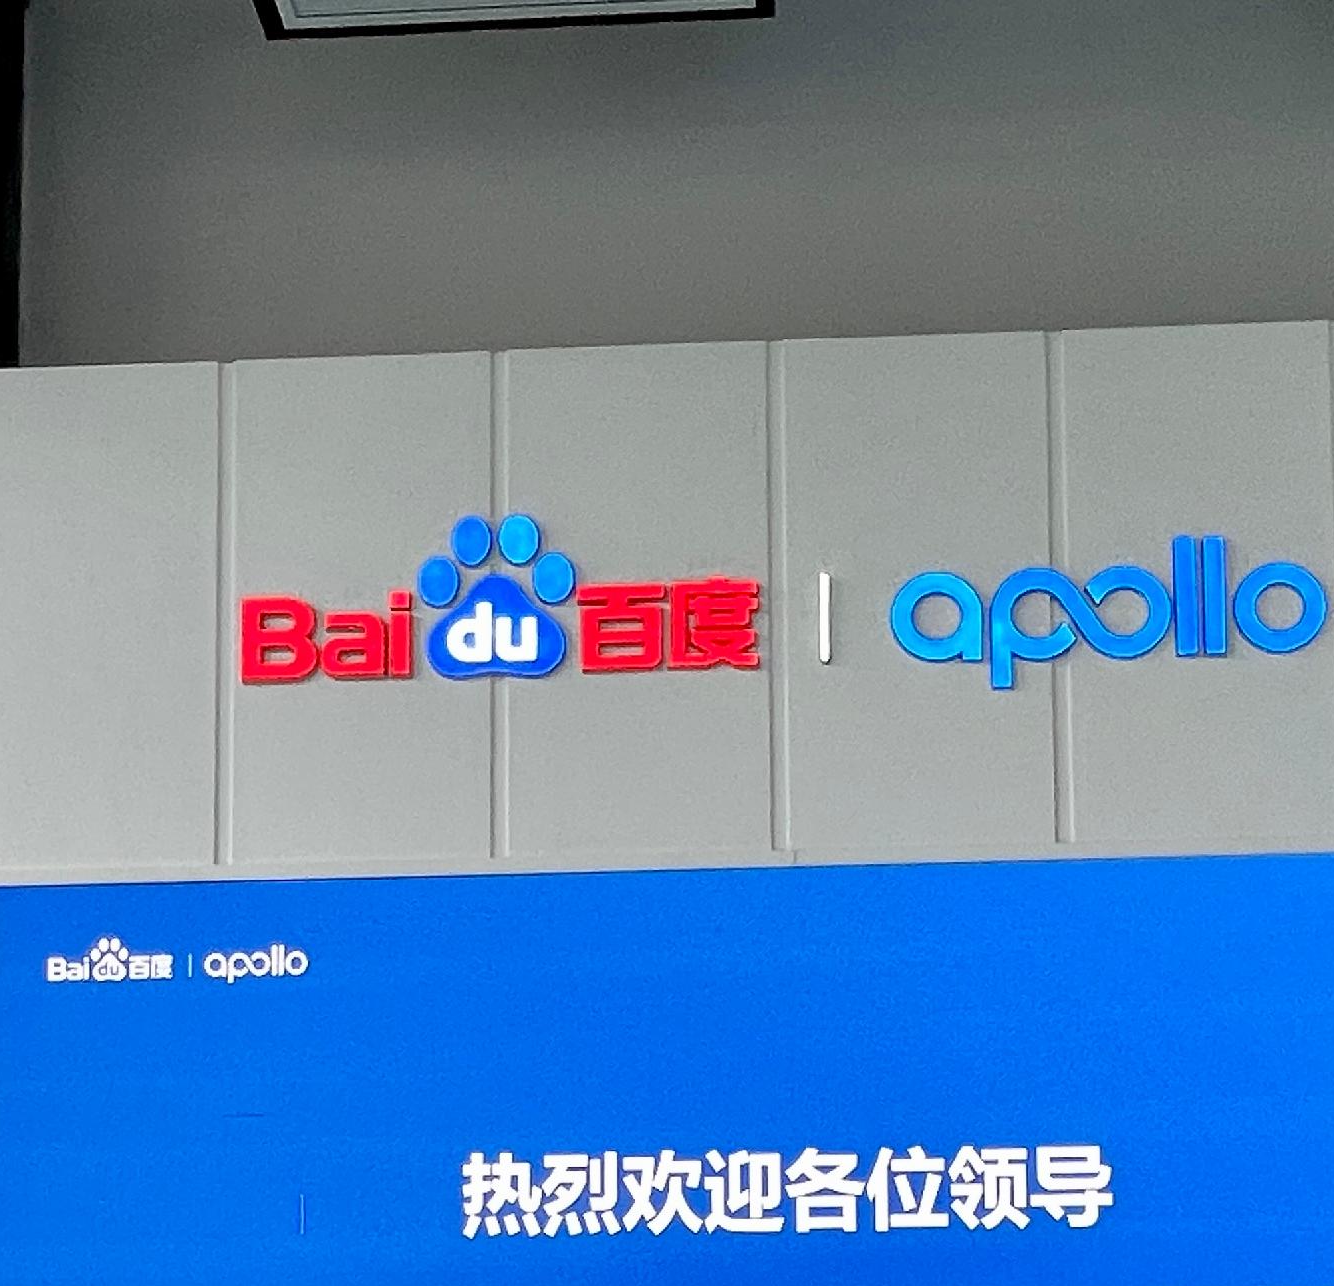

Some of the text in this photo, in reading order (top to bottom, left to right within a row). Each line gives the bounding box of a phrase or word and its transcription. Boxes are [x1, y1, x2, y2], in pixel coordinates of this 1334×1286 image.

[889, 534, 1329, 691] apollo
[204, 944, 309, 984] apollo
[460, 1144, 1115, 1241] 热烈欢迎各位领导
